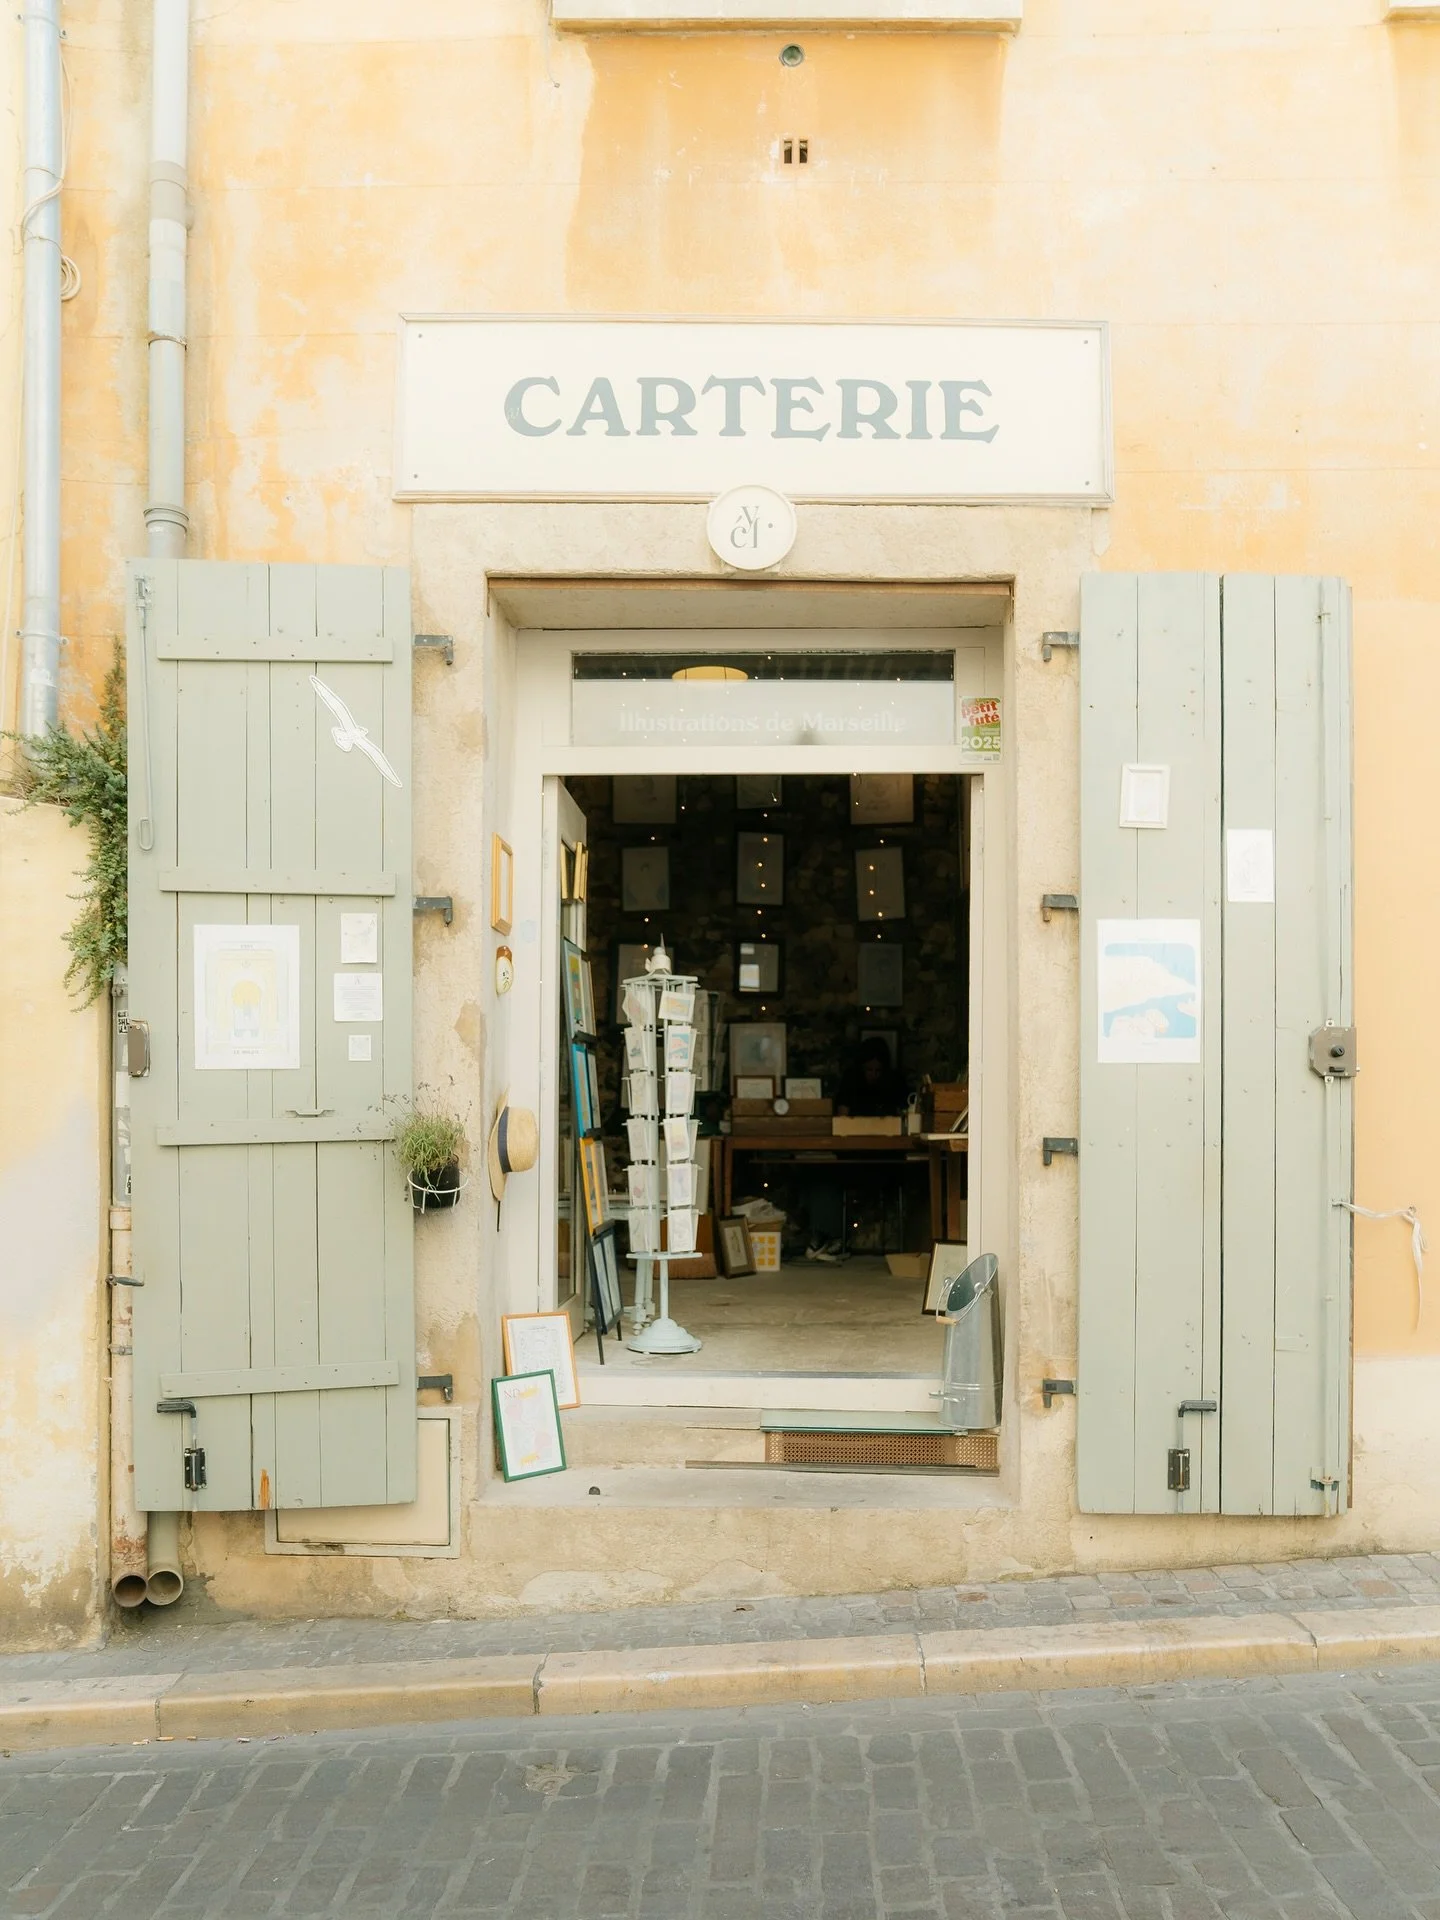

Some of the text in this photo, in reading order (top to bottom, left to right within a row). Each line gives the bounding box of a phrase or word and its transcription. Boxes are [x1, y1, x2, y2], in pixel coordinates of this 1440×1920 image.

[503, 374, 999, 444] CARTERIE
[961, 700, 998, 719] petit
[969, 712, 1000, 726] futé
[619, 711, 908, 732] Illustrations de Marseille
[962, 736, 1000, 749] 2025
